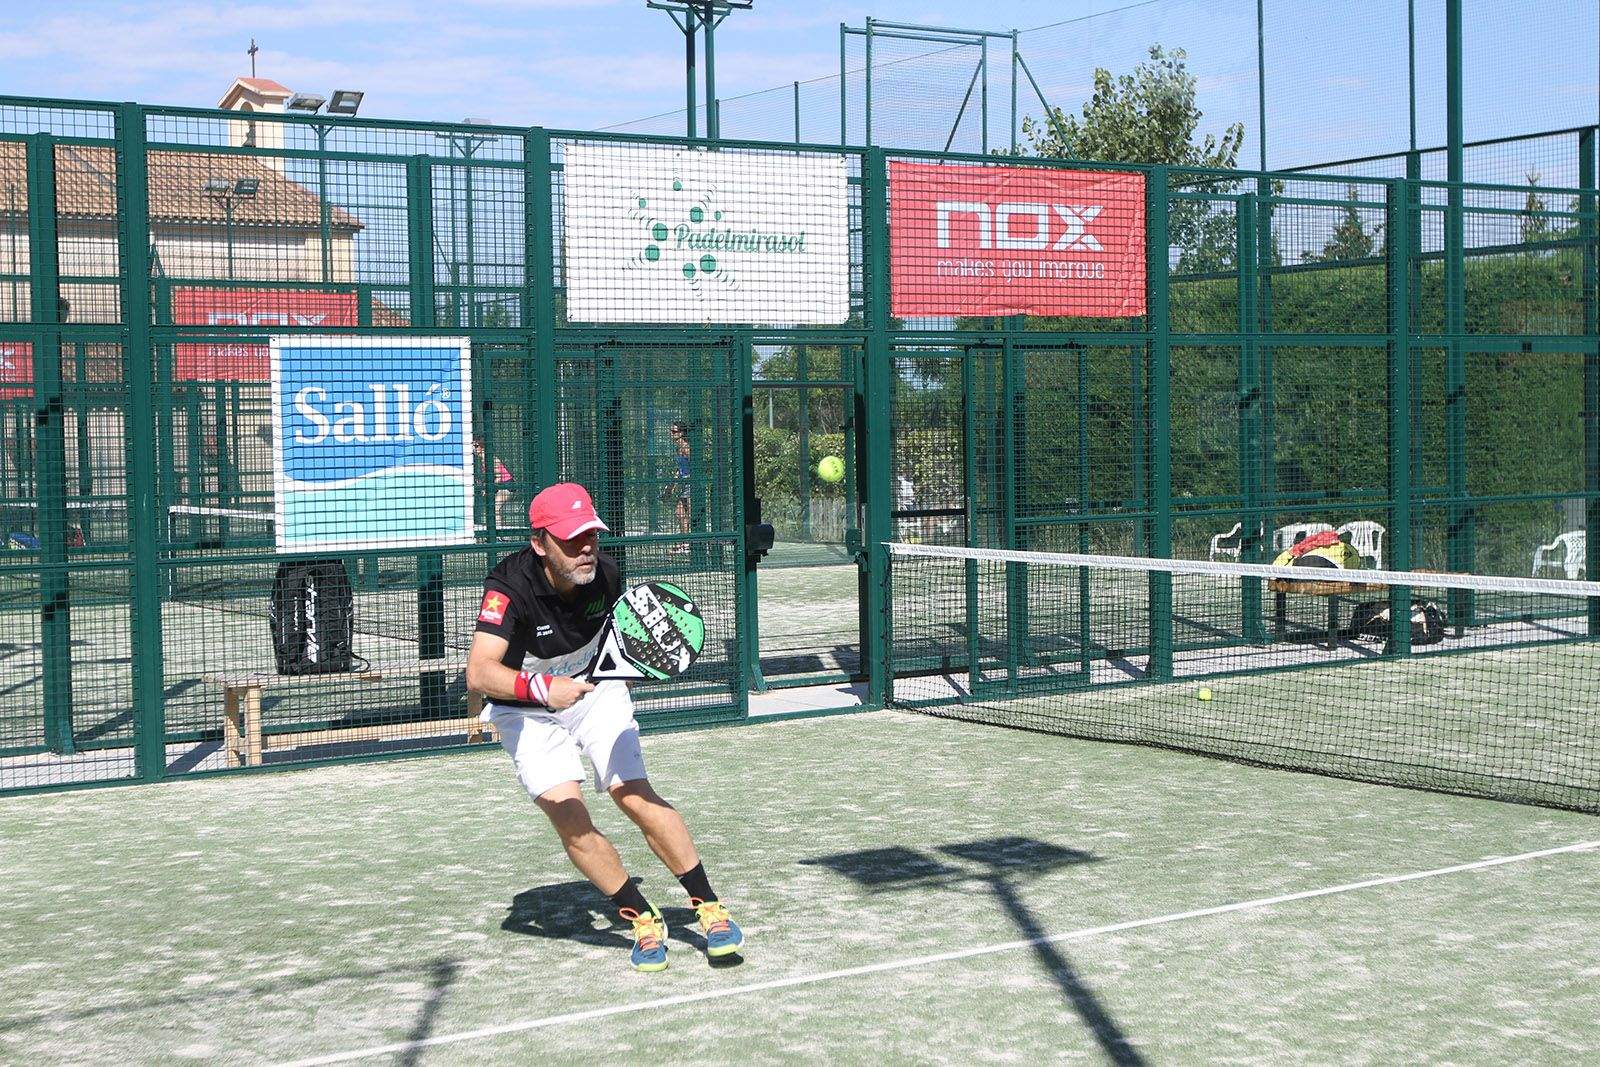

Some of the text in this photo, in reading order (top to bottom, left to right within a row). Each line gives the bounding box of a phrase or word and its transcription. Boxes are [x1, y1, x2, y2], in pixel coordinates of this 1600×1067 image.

[674, 223, 806, 253] Padelmirasol
[937, 258, 995, 278] makes
[1004, 261, 1032, 282] you
